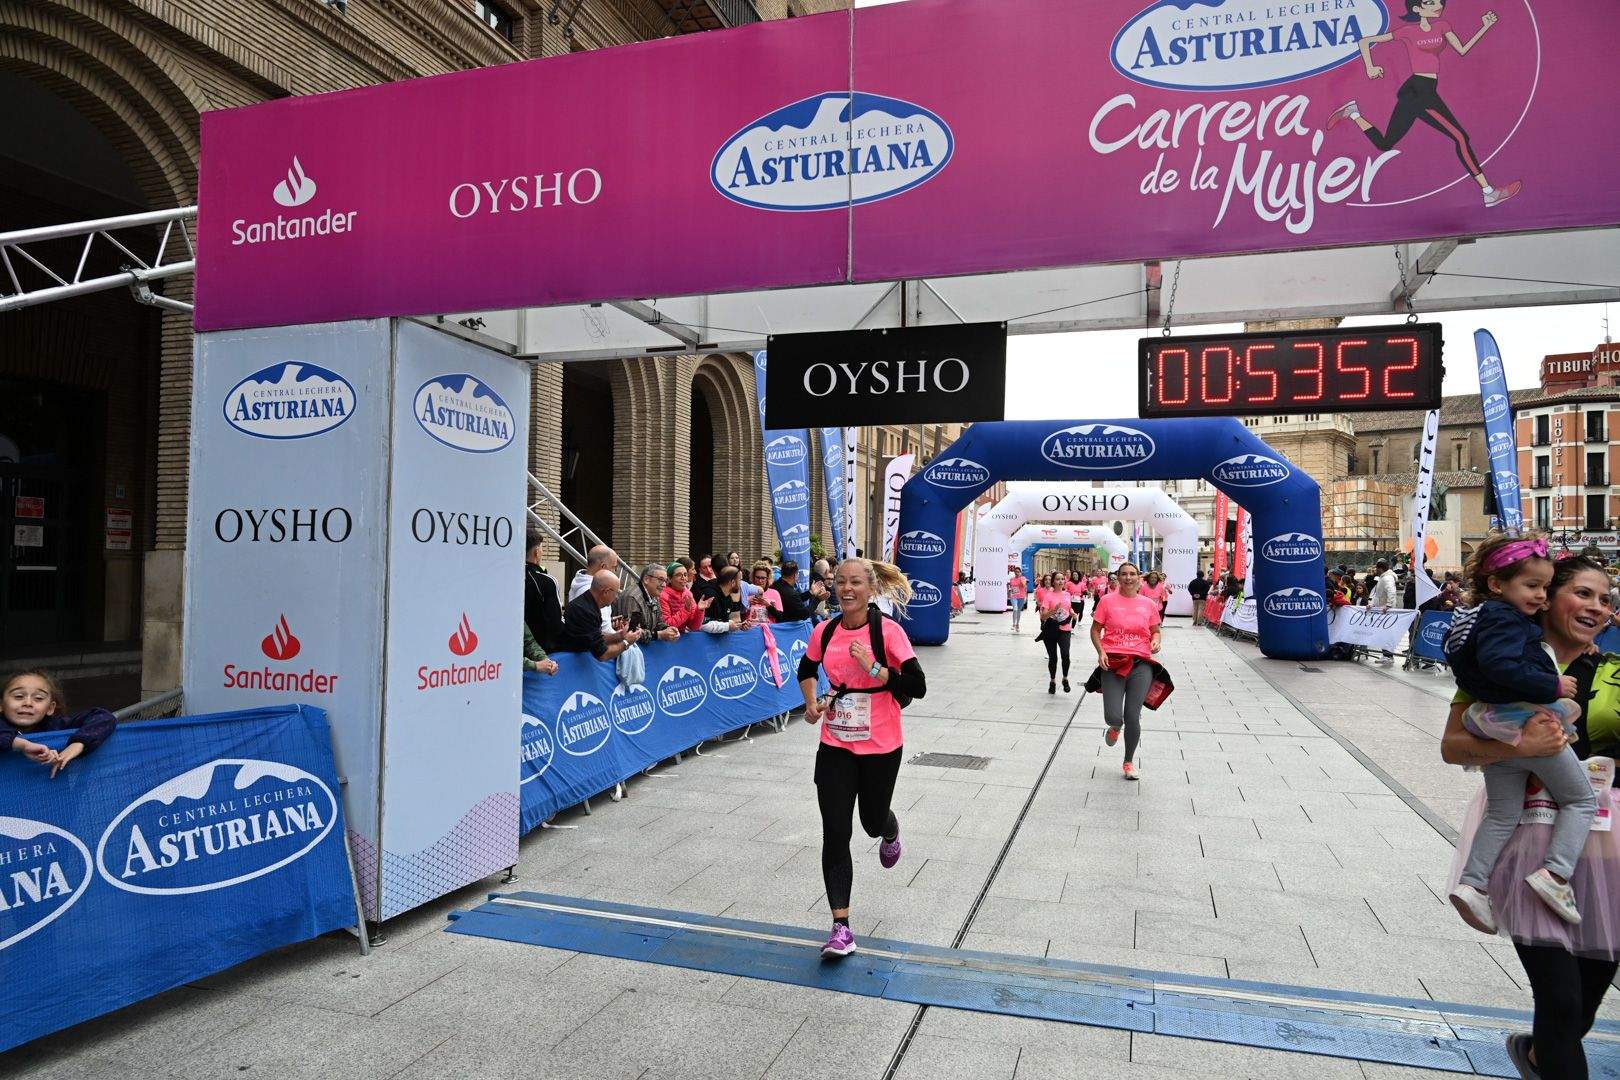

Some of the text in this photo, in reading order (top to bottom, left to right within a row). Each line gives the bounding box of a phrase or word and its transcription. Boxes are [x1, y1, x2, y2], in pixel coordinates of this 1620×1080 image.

[1171, 0, 1356, 31] CENTRAL LECHERA
[1130, 14, 1365, 70] ASTURIANA
[764, 122, 925, 152] CENTRAL LECHERA
[1088, 93, 1310, 154] Carrera
[728, 139, 934, 189] ASTURIANA
[448, 168, 602, 218] OYSHO
[1139, 130, 1401, 234] de la Mujer
[232, 208, 357, 246] Santander
[803, 358, 970, 397] OYSHO
[1548, 351, 1620, 374] TIBUR HO
[253, 386, 343, 398] CENTRAL LECHERA
[438, 394, 508, 419] CENTRAL LECHERA
[233, 393, 346, 422] ASTURIANA
[421, 393, 509, 441] ASTURIANA
[1049, 438, 1147, 458] ASTURIANA
[927, 468, 984, 482] ASTURIANA
[1218, 468, 1284, 480] ASTURIANA
[1042, 494, 1130, 512] OYSHO
[1555, 473, 1563, 522] TIBUR
[215, 507, 353, 543] OYSHO
[411, 508, 513, 548] OYSHO
[899, 541, 943, 553] ASTURIANA
[1266, 545, 1319, 557] ASTURIANA
[911, 592, 938, 602] RIANA
[1268, 598, 1321, 611] ASTURIANA
[1350, 609, 1398, 630] OYSHO
[223, 664, 338, 694] Santander
[417, 660, 503, 690] Santander
[714, 671, 755, 692] ASTURIANA
[661, 684, 705, 709] ASTURIANA
[614, 700, 653, 725] ASTURIANA
[561, 714, 610, 747] ASTURIANA
[159, 786, 313, 828] CENTRAL LECHERA
[0, 841, 57, 866] HERA
[121, 801, 325, 879] ASTURIANA
